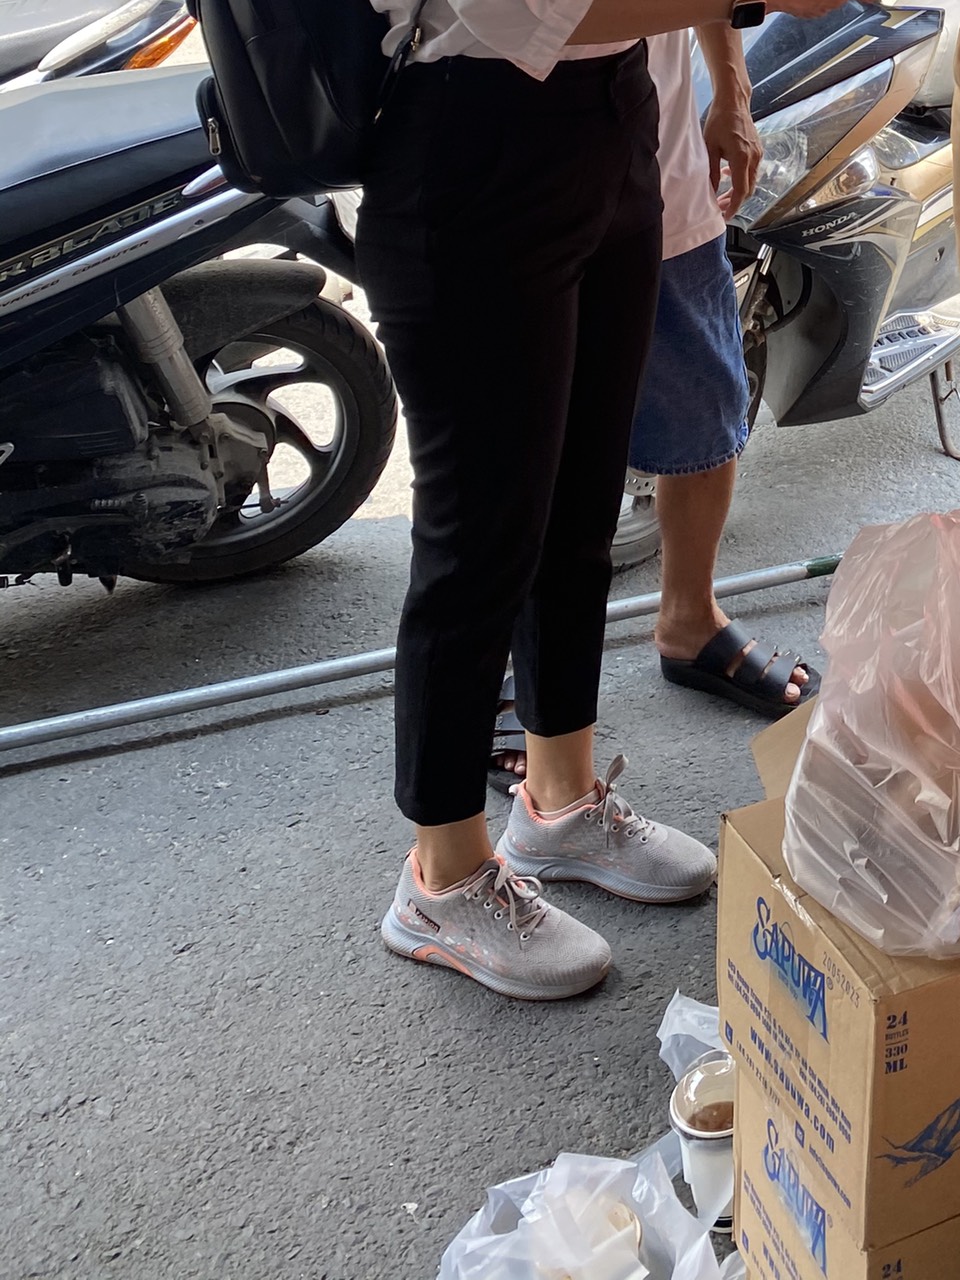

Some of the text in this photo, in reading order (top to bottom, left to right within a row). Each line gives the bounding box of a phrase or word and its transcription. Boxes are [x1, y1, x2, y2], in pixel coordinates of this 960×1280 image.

[31, 192, 182, 269] BLADE
[801, 211, 861, 238] HONDA
[753, 896, 830, 1045] SAPUWA
[886, 1011, 909, 1030] 24
[885, 1043, 908, 1059] 330
[885, 1058, 908, 1074] ML
[750, 1026, 835, 1154] www.sapuwa.com
[882, 1258, 902, 1280] 24
